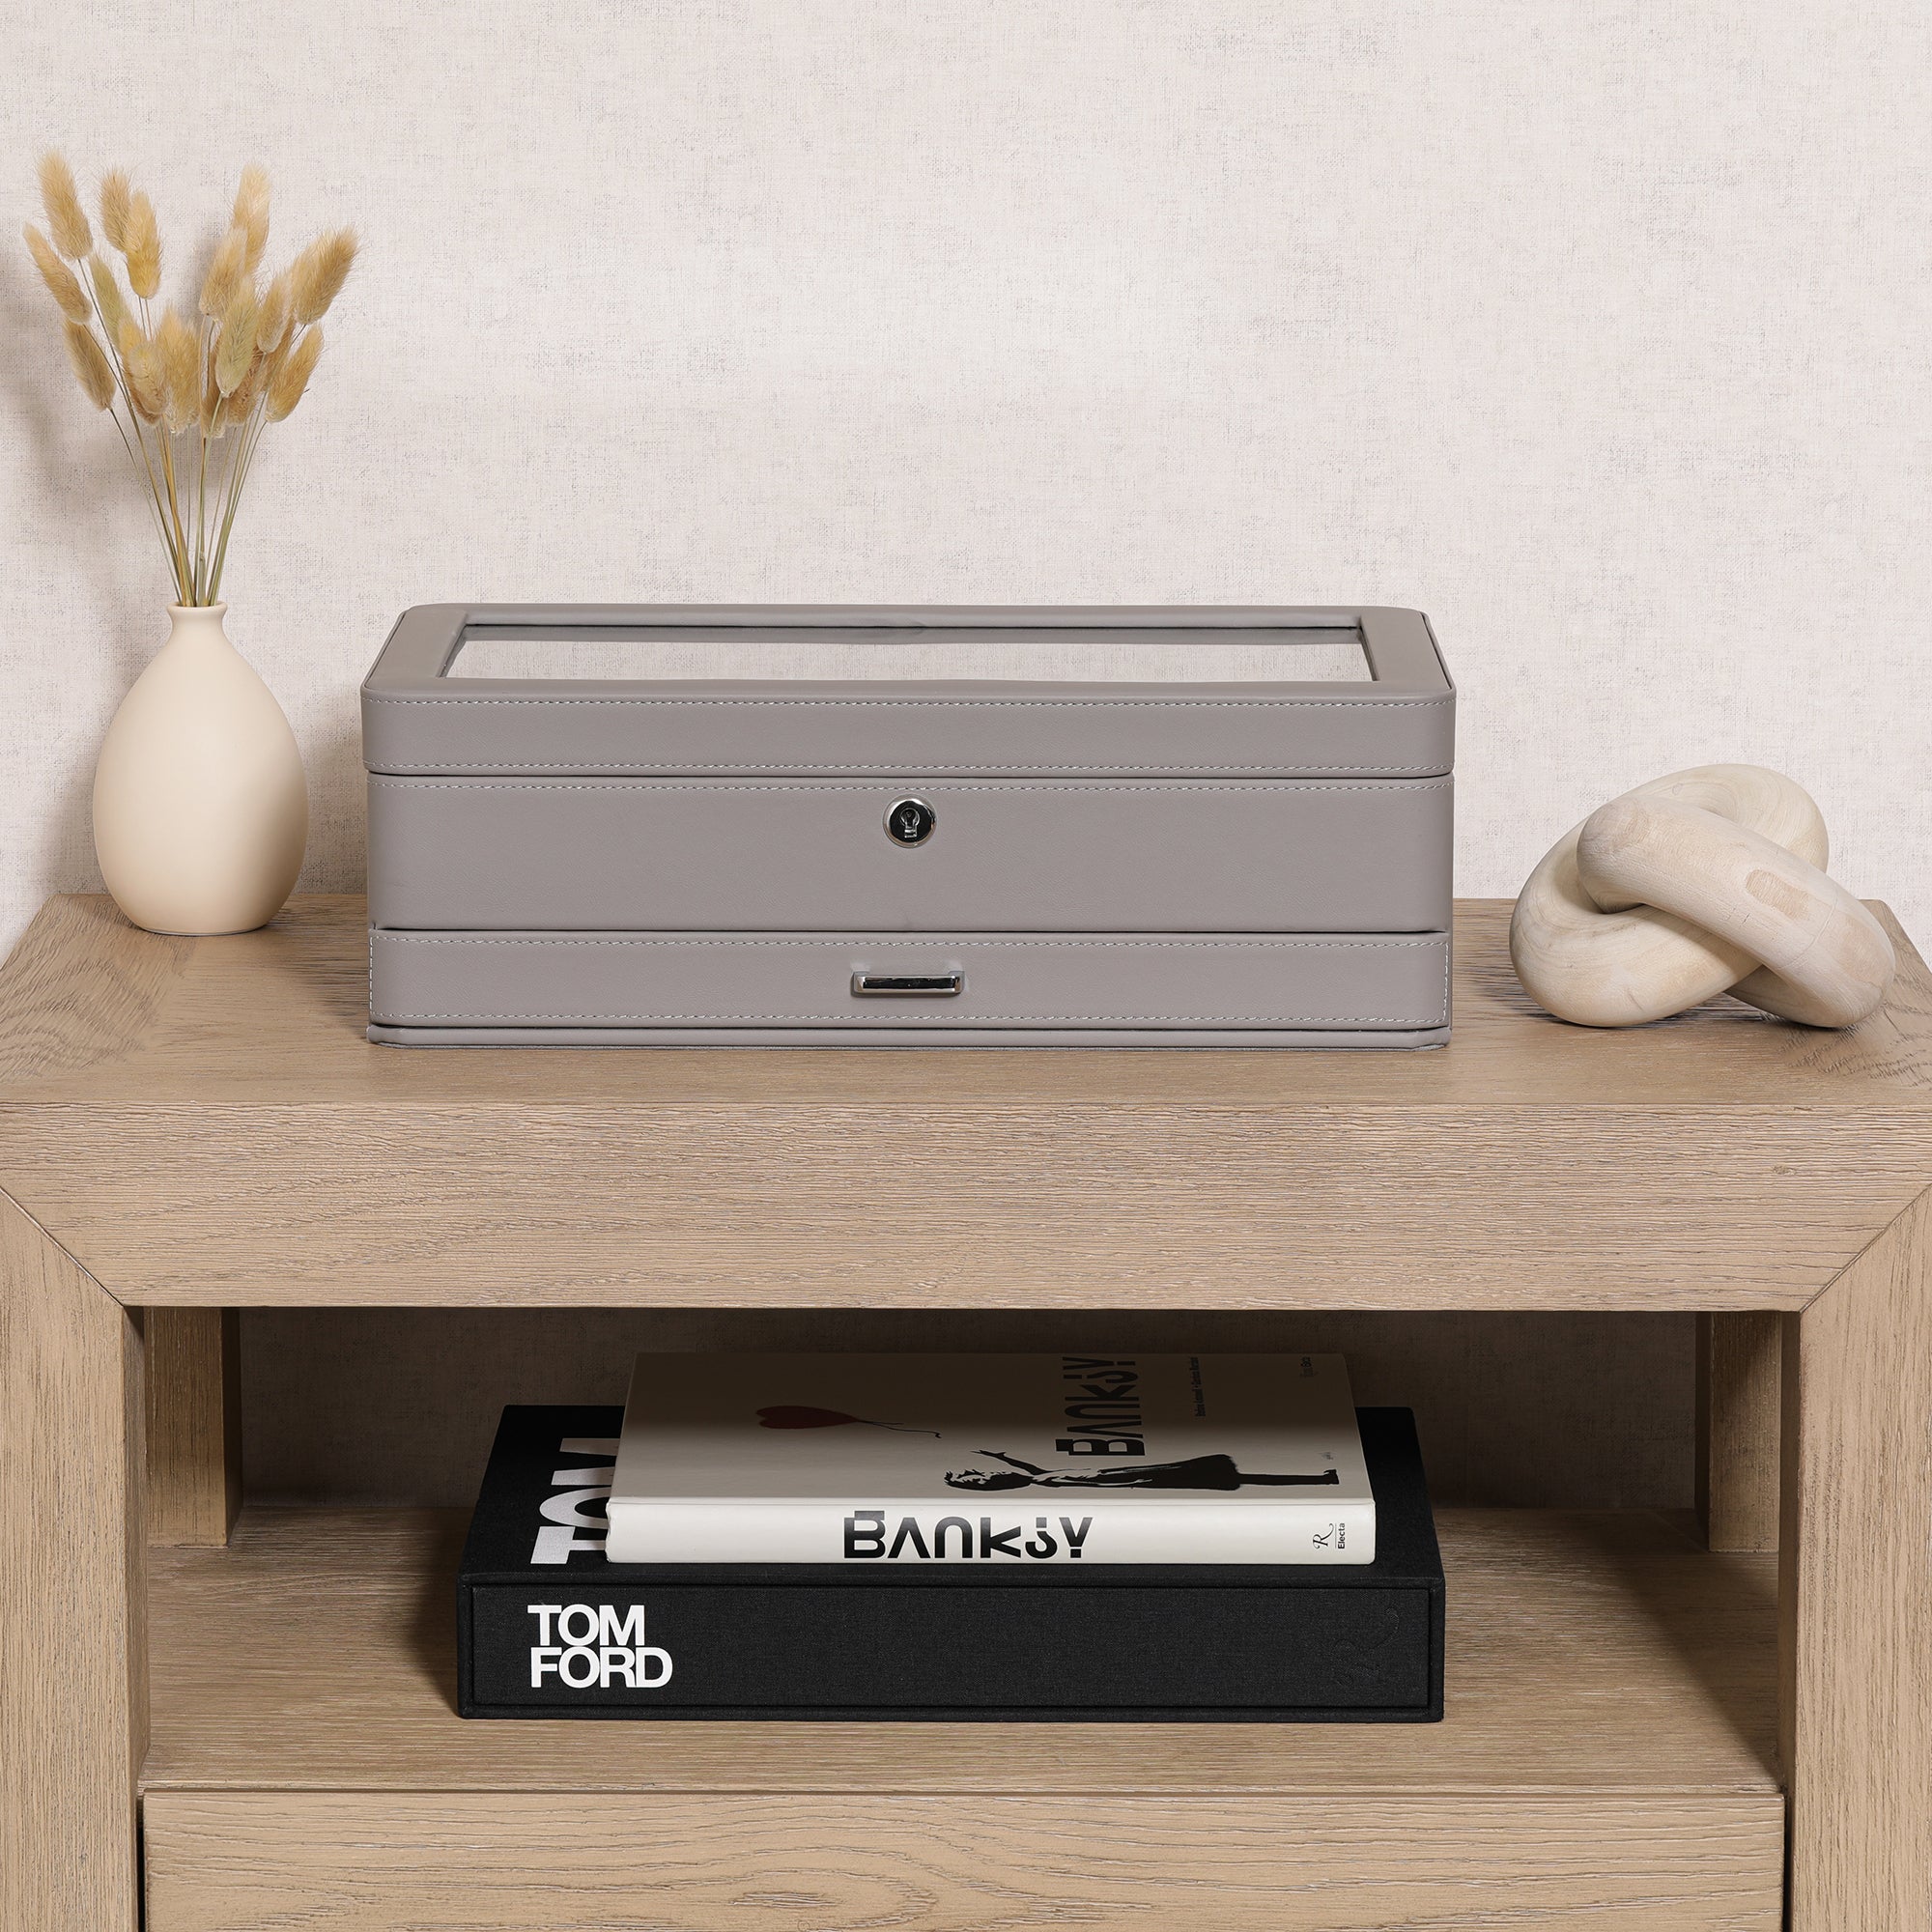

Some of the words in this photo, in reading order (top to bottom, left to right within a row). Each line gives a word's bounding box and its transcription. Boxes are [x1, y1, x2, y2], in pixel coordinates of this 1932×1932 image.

[1312, 1522, 1334, 1549] R
[1337, 1522, 1346, 1549] Electa
[527, 1604, 644, 1646] TOM
[530, 1646, 673, 1688] FORD
